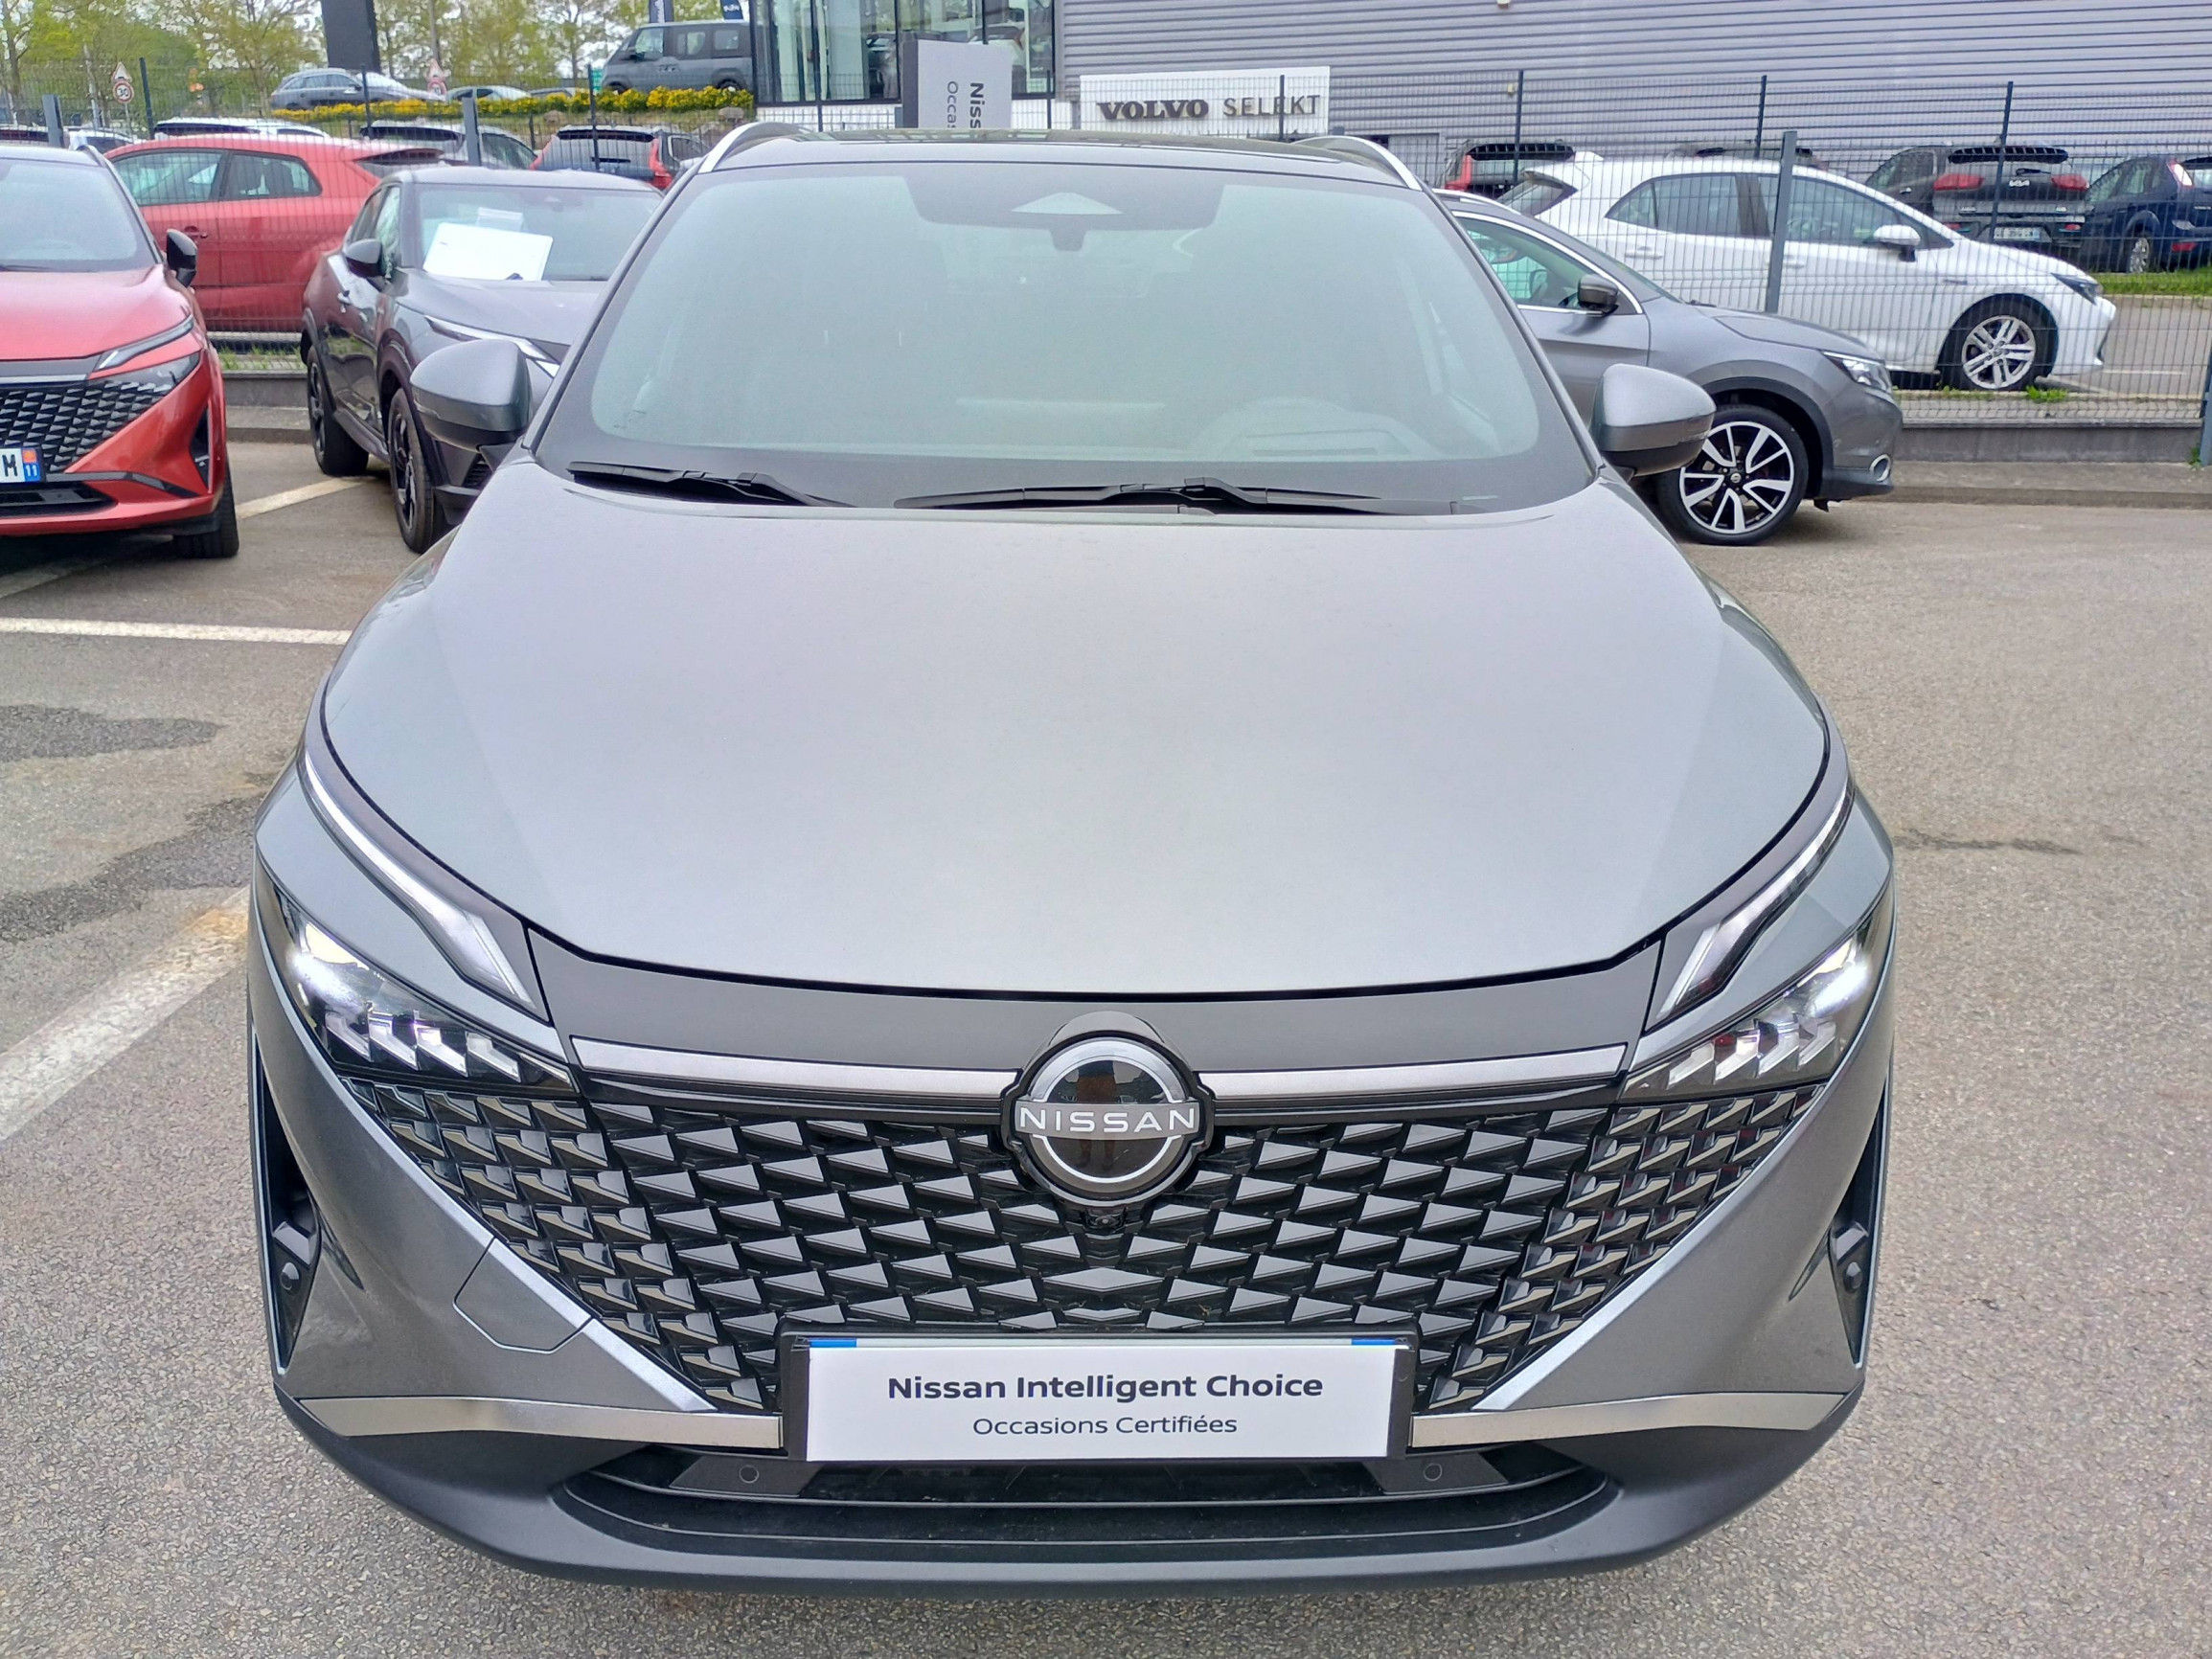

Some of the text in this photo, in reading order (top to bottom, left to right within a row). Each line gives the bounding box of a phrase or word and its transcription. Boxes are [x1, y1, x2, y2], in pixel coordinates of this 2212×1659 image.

[1096, 99, 1210, 121] VOLVO
[25, 465, 37, 477] 11
[1020, 1107, 1195, 1133] NISSAN
[888, 1374, 1323, 1404] Nissan Intelligent Choice
[972, 1414, 1238, 1436] Occasions Certifiées
